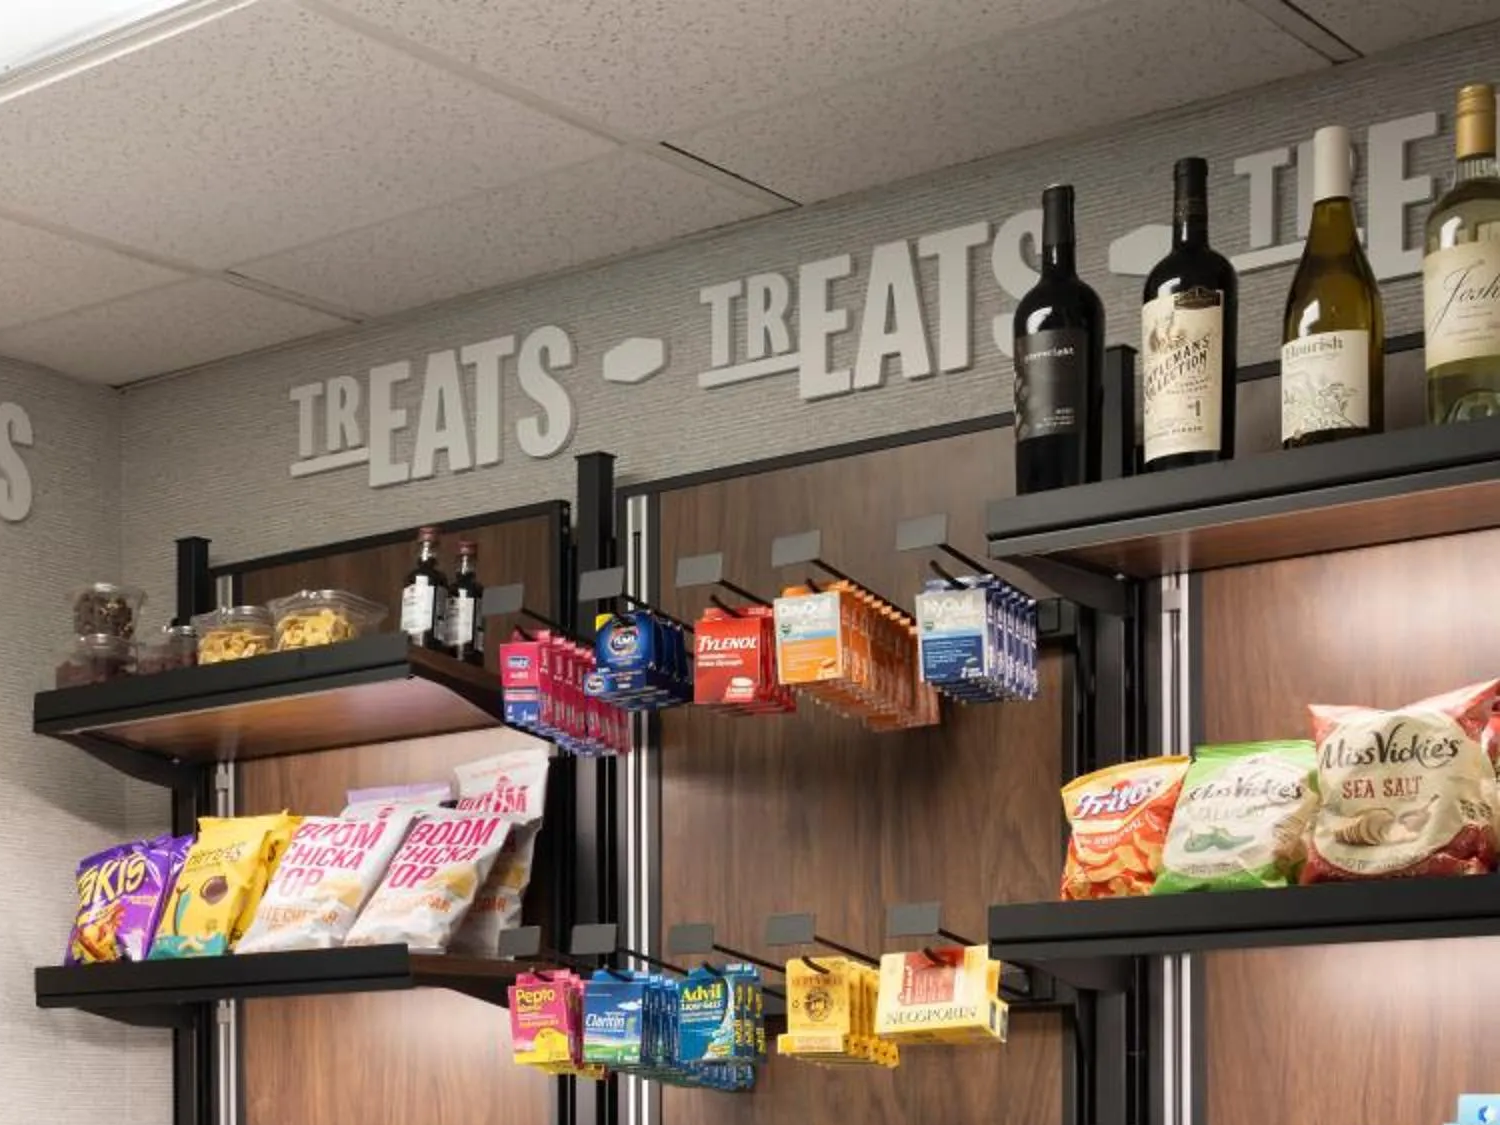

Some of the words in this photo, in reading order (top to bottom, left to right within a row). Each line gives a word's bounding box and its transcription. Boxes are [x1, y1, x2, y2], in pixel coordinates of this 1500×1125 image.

[290, 325, 574, 488] TREATS
[698, 635, 759, 651] TYLENOL
[1371, 723, 1462, 770] Vickie's
[1341, 778, 1380, 801] SEA
[1383, 775, 1423, 798] SALT
[293, 821, 388, 849] BOOM
[408, 818, 501, 846] BOOM
[516, 988, 555, 1004] Pepto
[682, 984, 723, 1002] Advil
